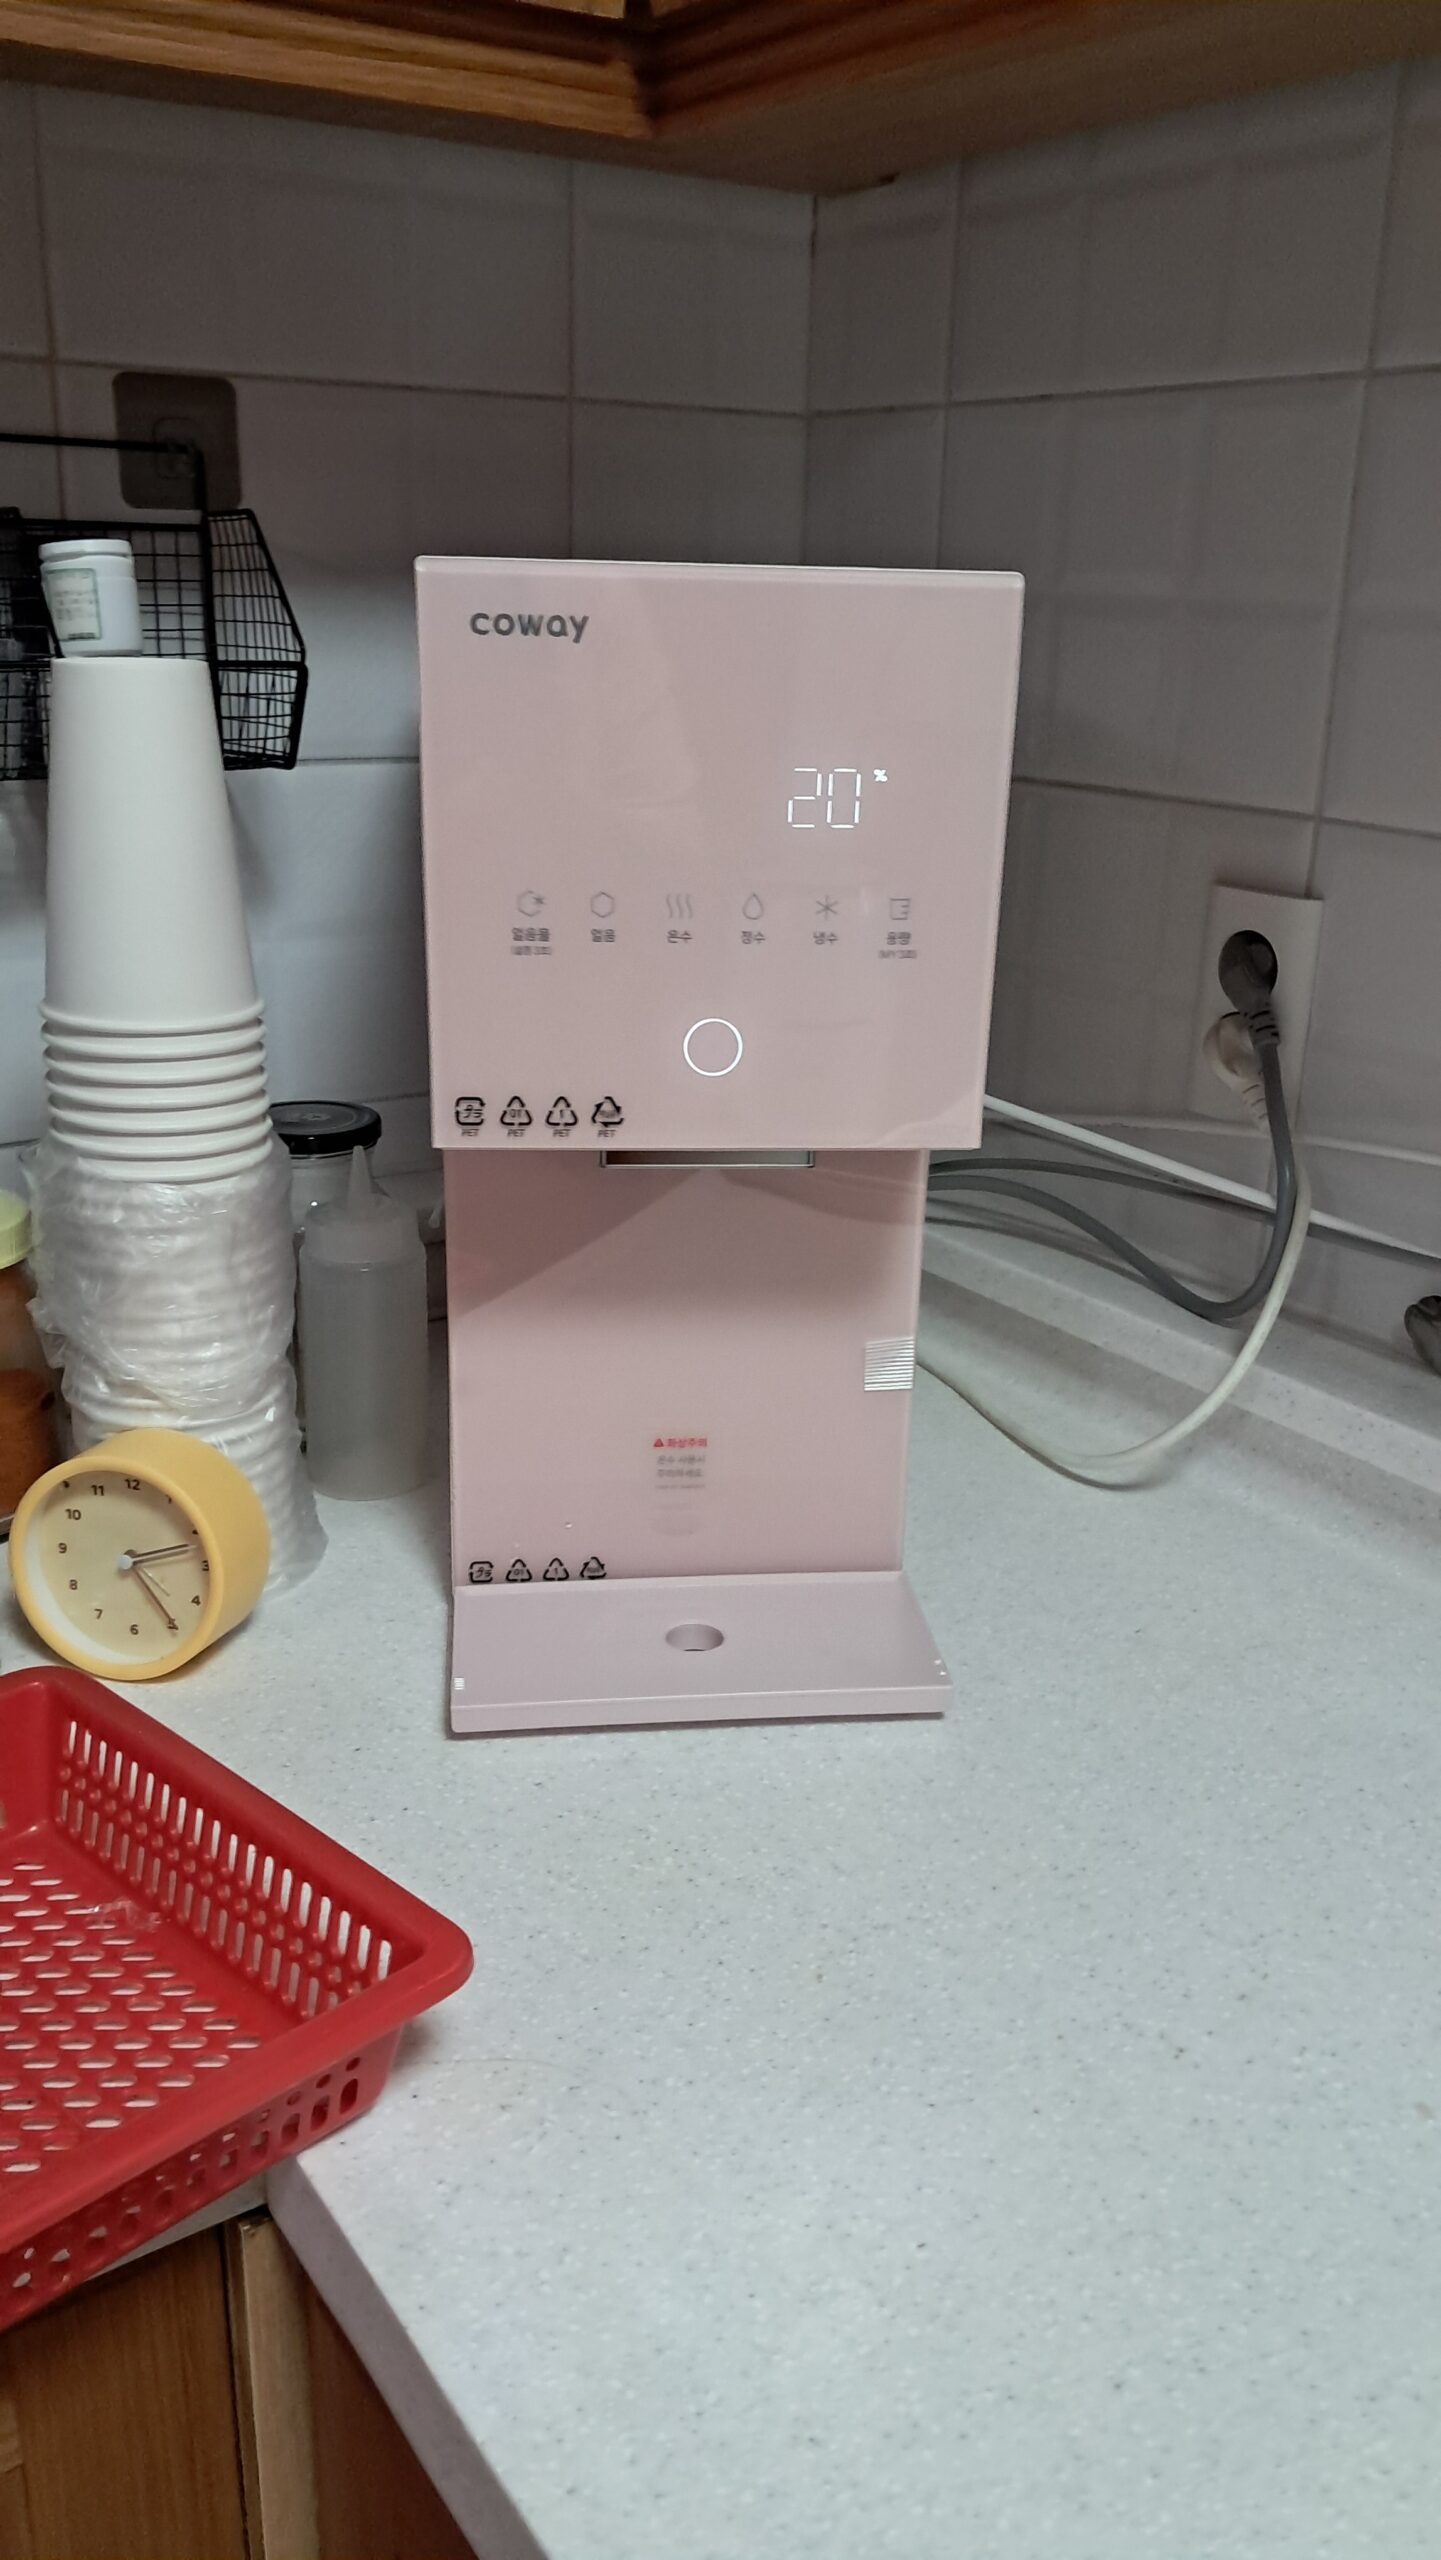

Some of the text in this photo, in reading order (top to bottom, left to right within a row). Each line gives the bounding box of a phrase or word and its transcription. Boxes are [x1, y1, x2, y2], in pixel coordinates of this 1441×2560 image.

[470, 612, 590, 644] coway
[590, 928, 616, 943] 얼음
[667, 929, 693, 944] 온수
[741, 930, 766, 945] 정수
[812, 931, 839, 945] 냉수
[461, 1128, 479, 1137] PET
[507, 1128, 525, 1137] PET
[553, 1128, 571, 1138] PET
[598, 1129, 616, 1138] PET
[91, 1484, 105, 1496] 11
[125, 1478, 141, 1491] 12
[65, 1508, 82, 1521] 10
[58, 1542, 68, 1554] 9
[201, 1559, 210, 1572] 3
[69, 1579, 78, 1591] 8
[190, 1594, 201, 1606] 4
[94, 1608, 103, 1620] 7
[130, 1624, 139, 1635] 6
